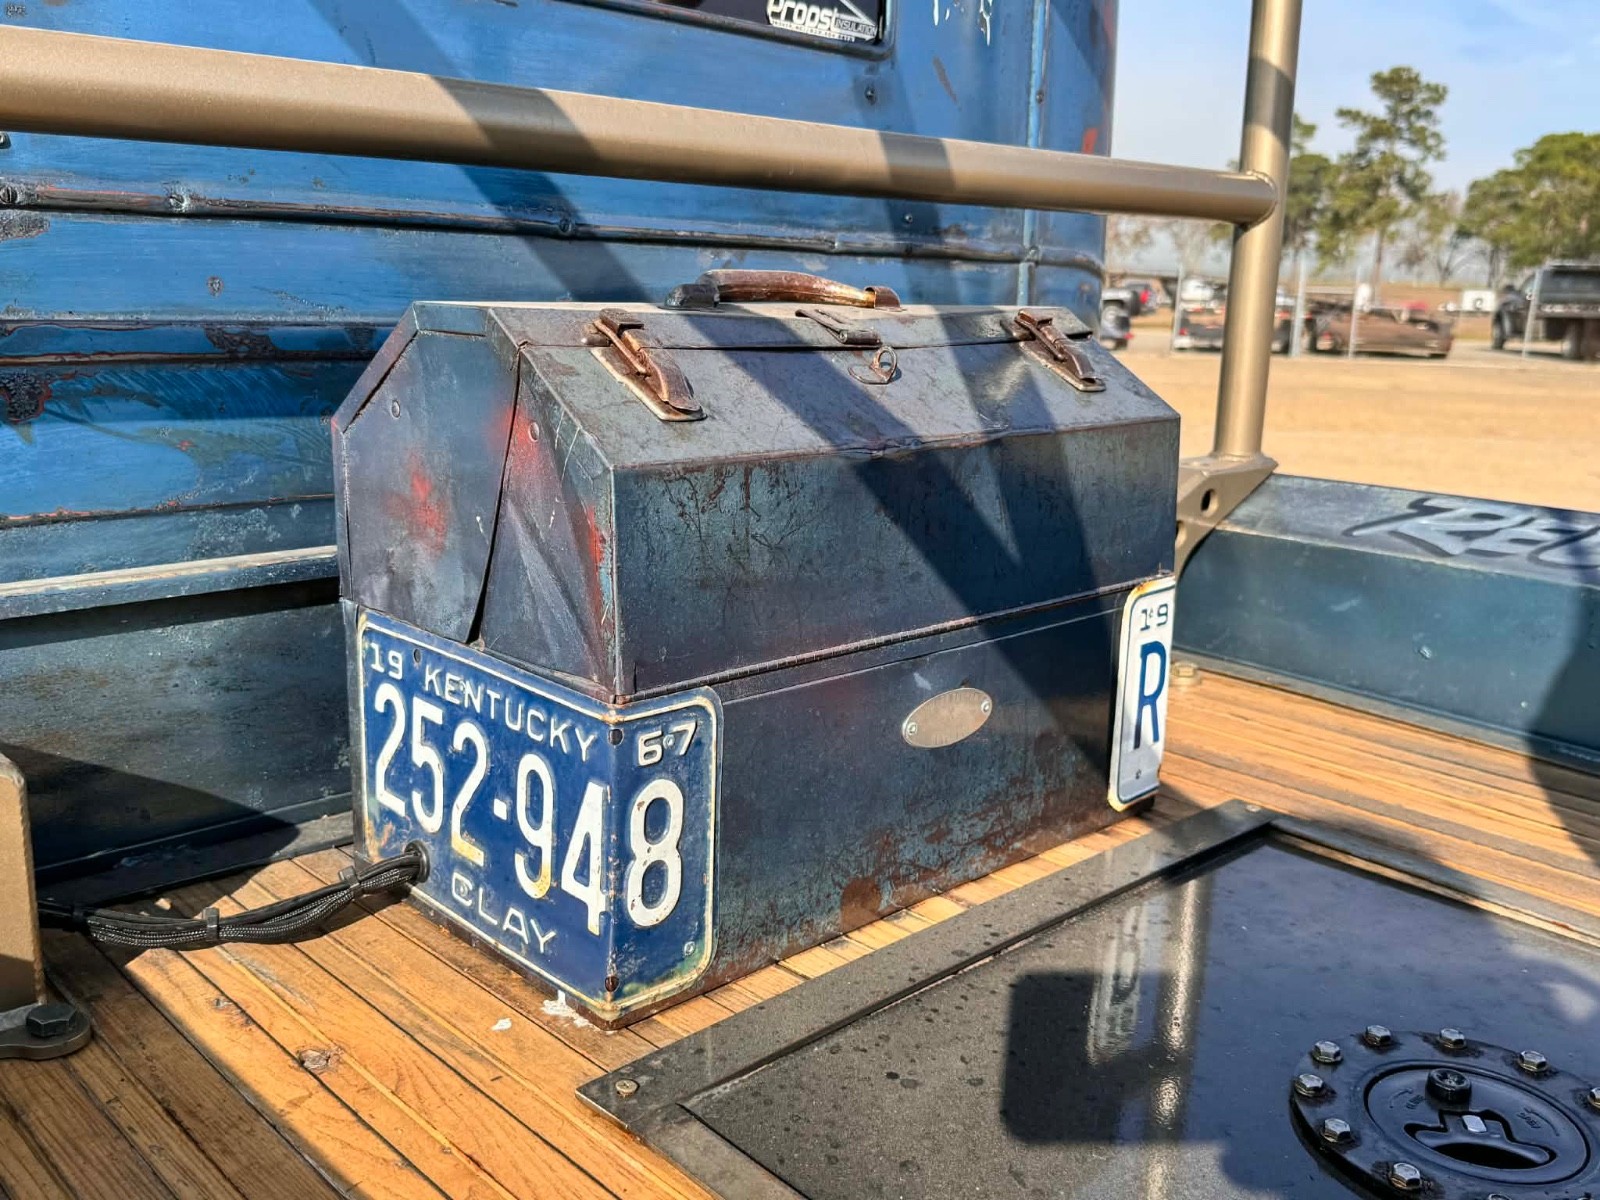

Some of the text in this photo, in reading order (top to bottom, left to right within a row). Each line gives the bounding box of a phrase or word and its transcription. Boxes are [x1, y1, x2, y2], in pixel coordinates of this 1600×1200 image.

[1140, 603, 1168, 632] 19
[370, 642, 699, 767] 19 KENTUCKY 67
[1133, 640, 1168, 750] R
[374, 682, 685, 937] 252-948
[451, 871, 558, 955] CLAY
